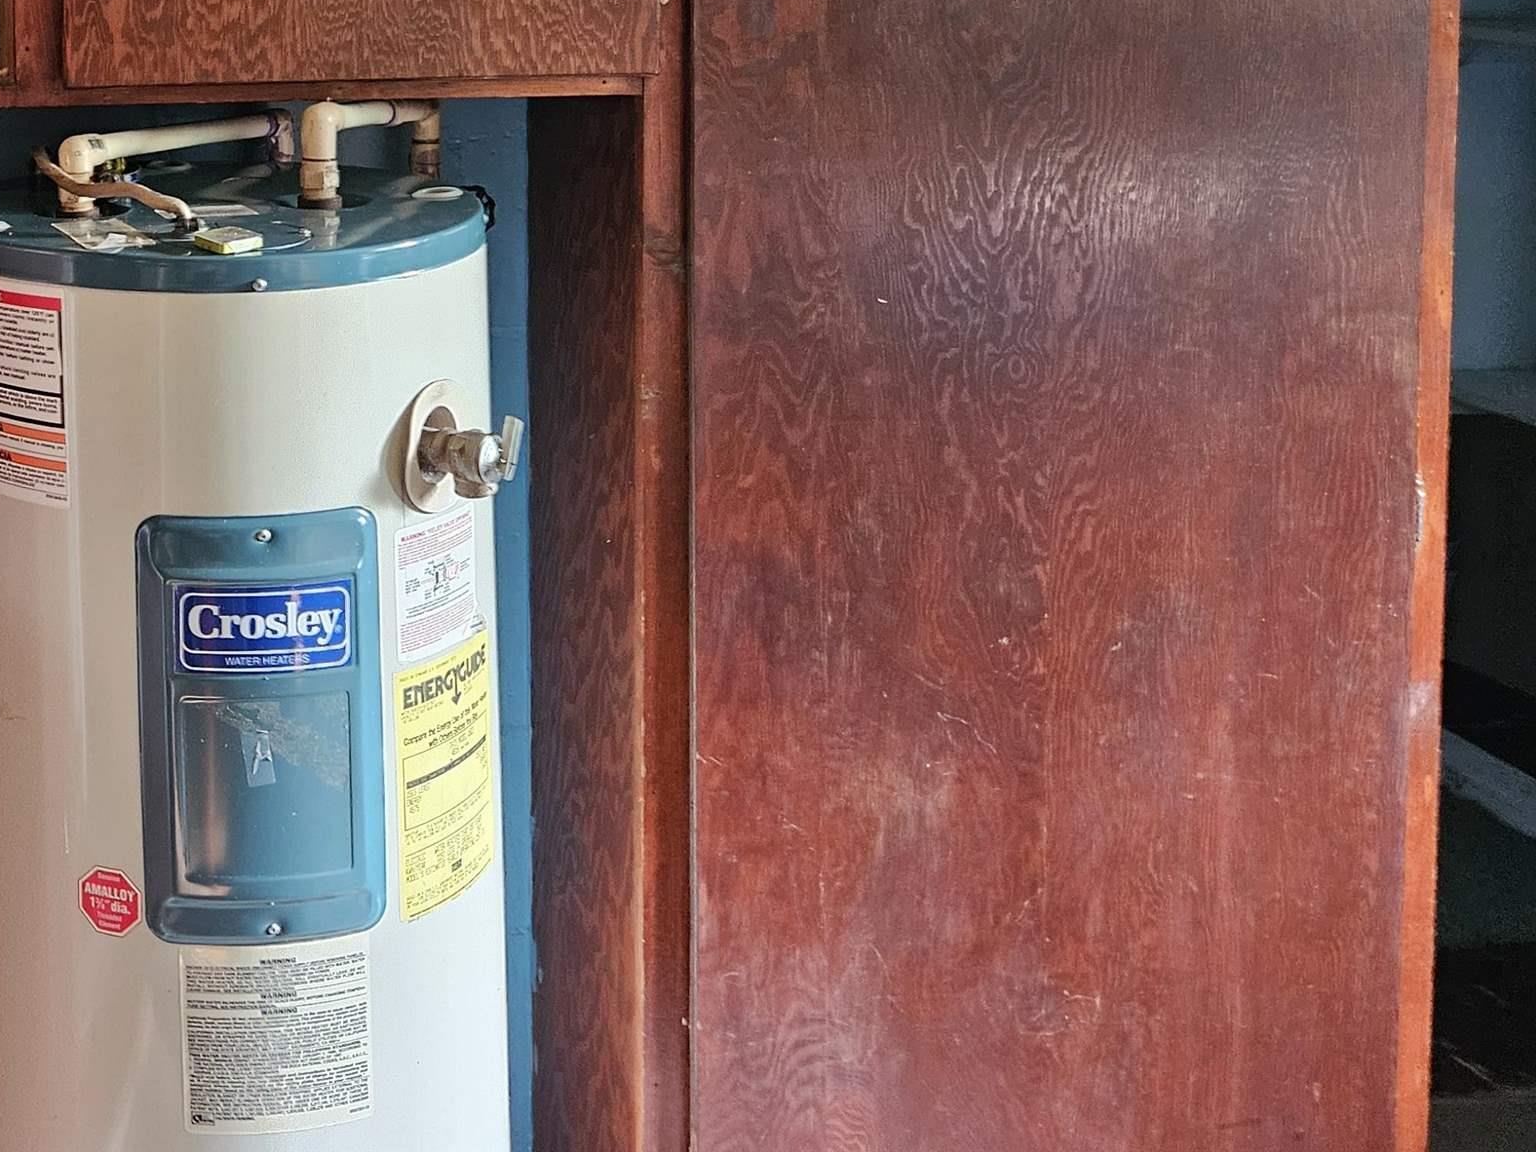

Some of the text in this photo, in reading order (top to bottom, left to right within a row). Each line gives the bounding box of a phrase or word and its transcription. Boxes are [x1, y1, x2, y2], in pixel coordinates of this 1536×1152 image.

[188, 601, 343, 646] Crosley
[224, 653, 310, 666] WATER HEATERS
[84, 882, 135, 903] AMALLOY
[110, 900, 131, 916] dia.
[259, 957, 297, 965] WARNING
[260, 991, 297, 1000] WARNING
[260, 1007, 298, 1016] WARNING
